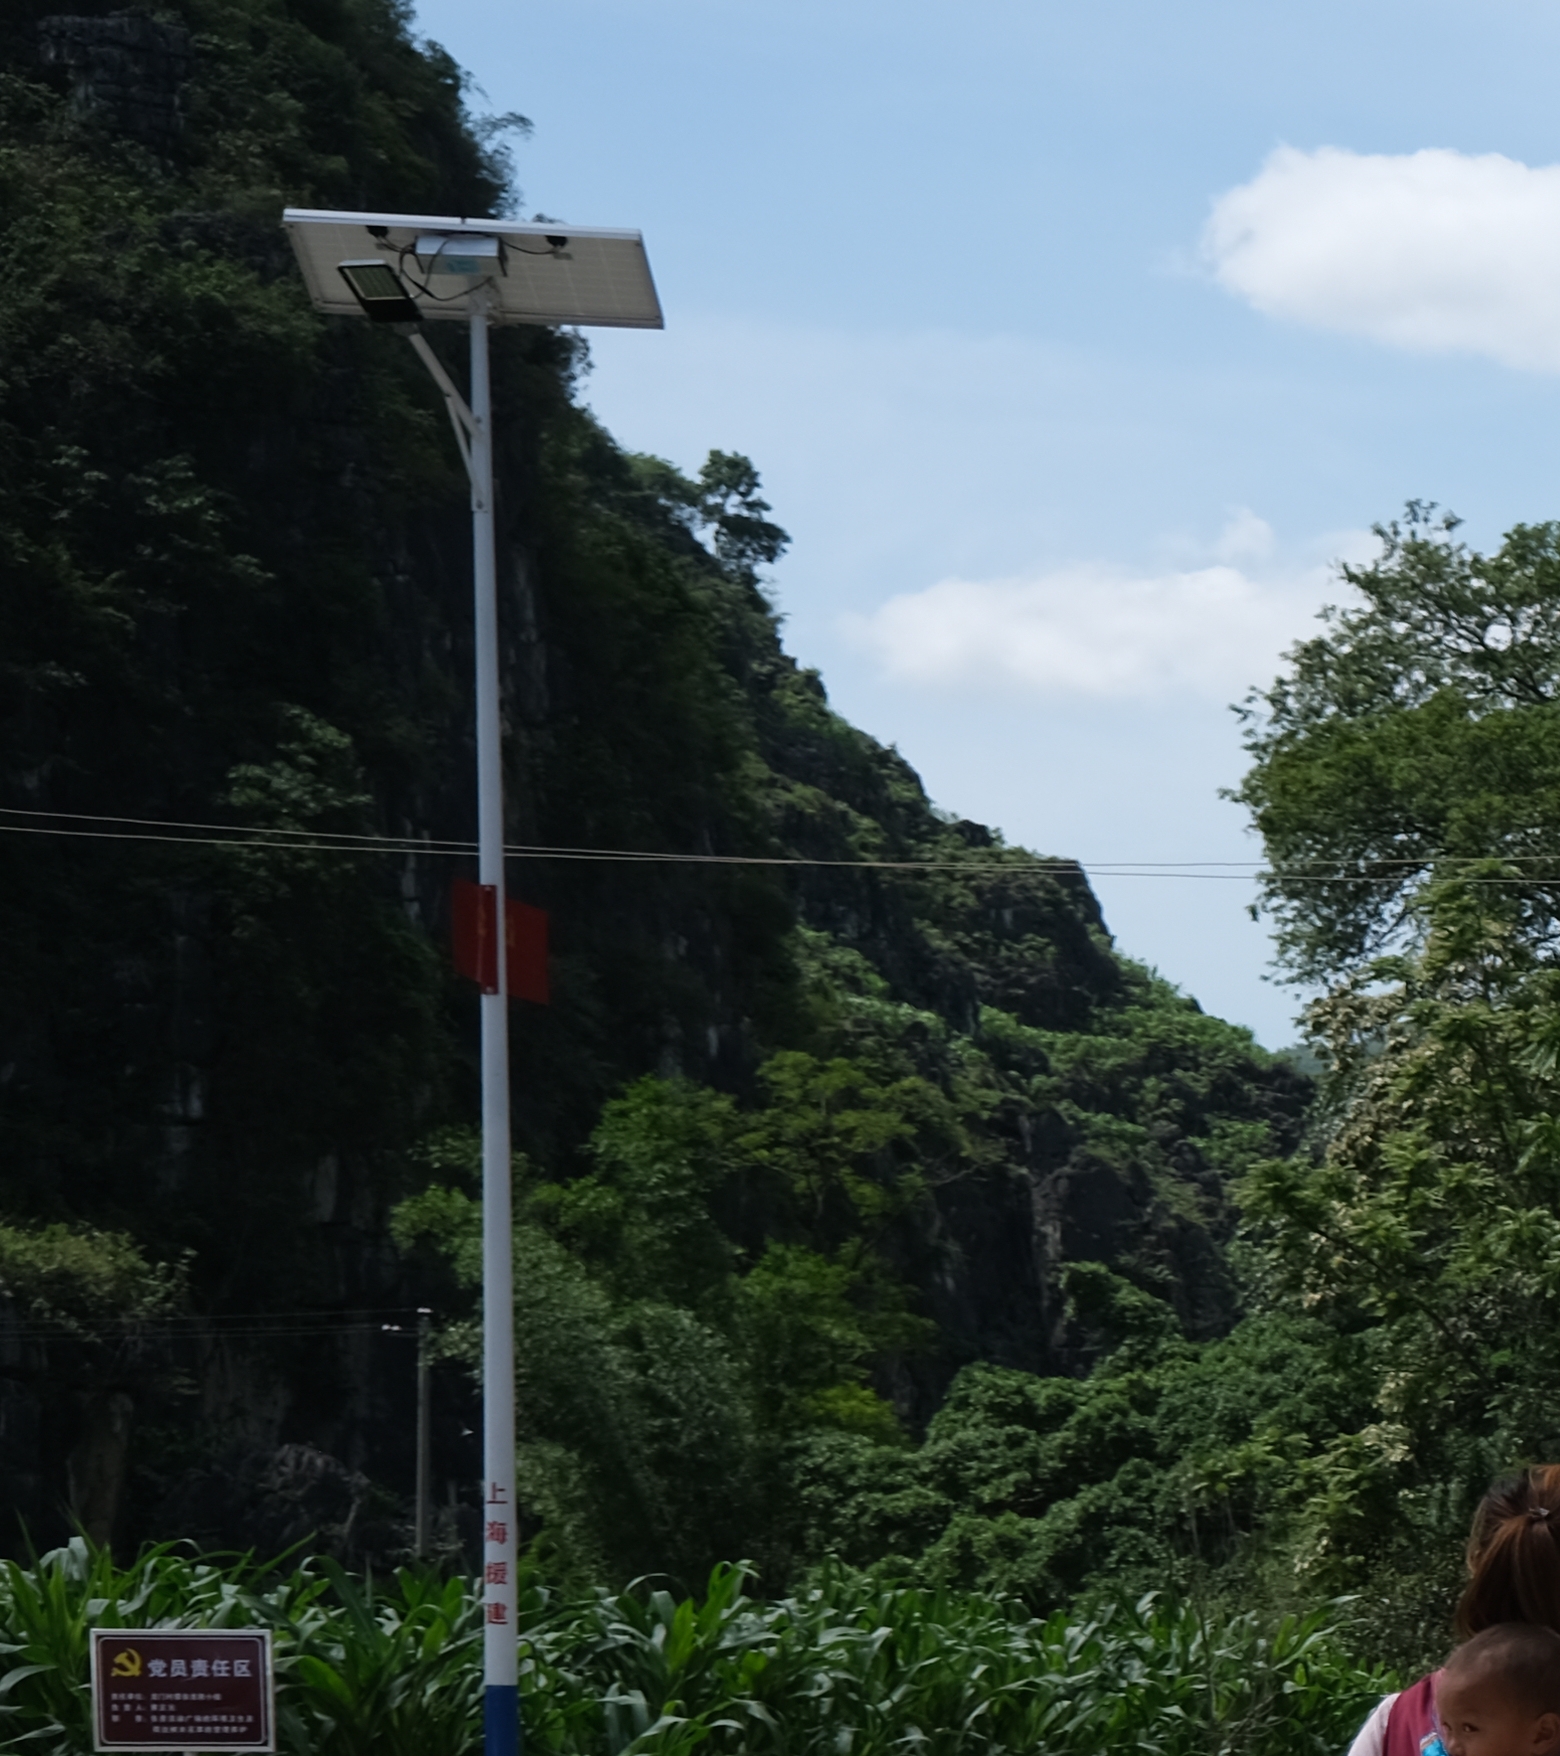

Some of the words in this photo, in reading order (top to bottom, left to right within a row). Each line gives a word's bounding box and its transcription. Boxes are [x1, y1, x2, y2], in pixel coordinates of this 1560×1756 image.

[486, 1481, 509, 1625] 上海援建
[147, 1659, 253, 1678] 党员责任区
